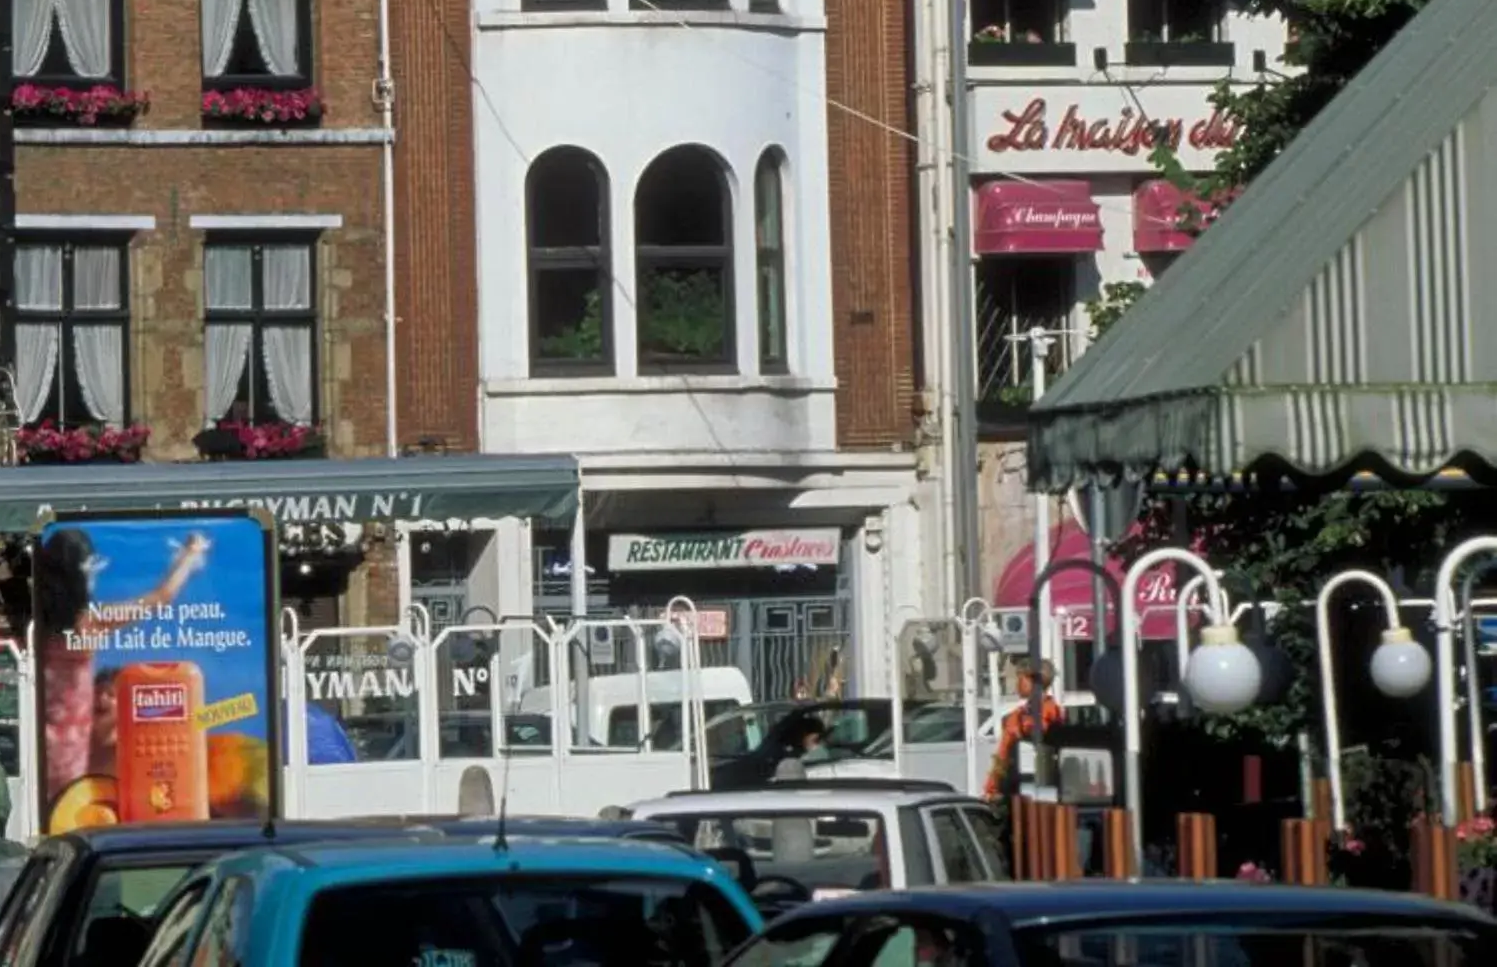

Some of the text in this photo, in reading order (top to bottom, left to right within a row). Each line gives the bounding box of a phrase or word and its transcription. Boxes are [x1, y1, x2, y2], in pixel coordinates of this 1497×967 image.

[987, 98, 1048, 153] La
[1013, 207, 1097, 229] Champagne
[626, 540, 745, 564] RESTAURANT
[88, 600, 226, 624] Nourris ta peau.
[63, 626, 252, 652] Tahiti Lait de Mangue.
[306, 669, 414, 700] YMAN
[137, 690, 183, 708] tahiti
